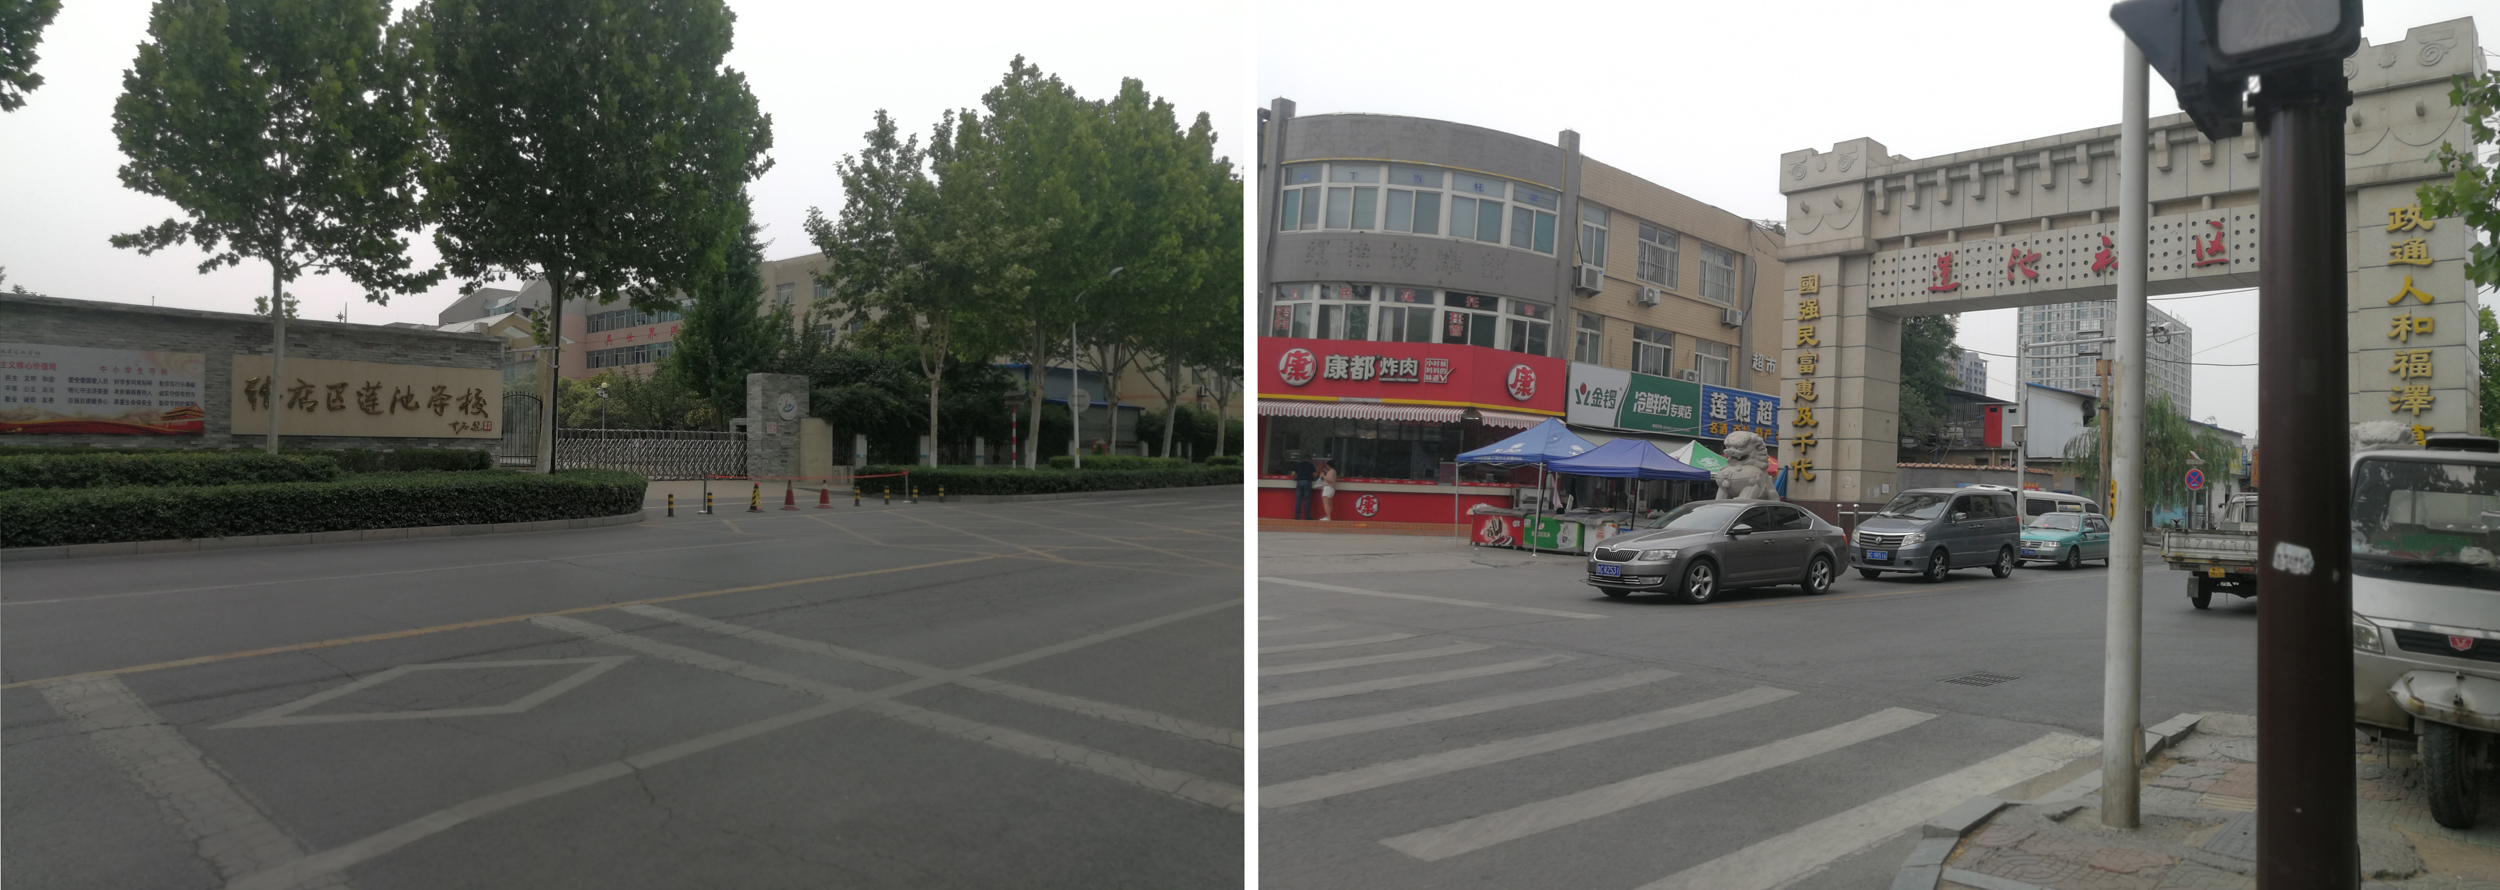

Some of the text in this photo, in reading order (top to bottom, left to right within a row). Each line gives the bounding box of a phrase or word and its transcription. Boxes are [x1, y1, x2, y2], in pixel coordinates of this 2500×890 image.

[1449, 312, 1464, 337] 托管
[1323, 354, 1419, 381] 康都 炸肉
[1752, 352, 1777, 374] 超市
[1633, 391, 1692, 419] 冷鲜肉 专卖店
[1709, 391, 1779, 426] 莲池超
[1709, 421, 1728, 435] 名酒
